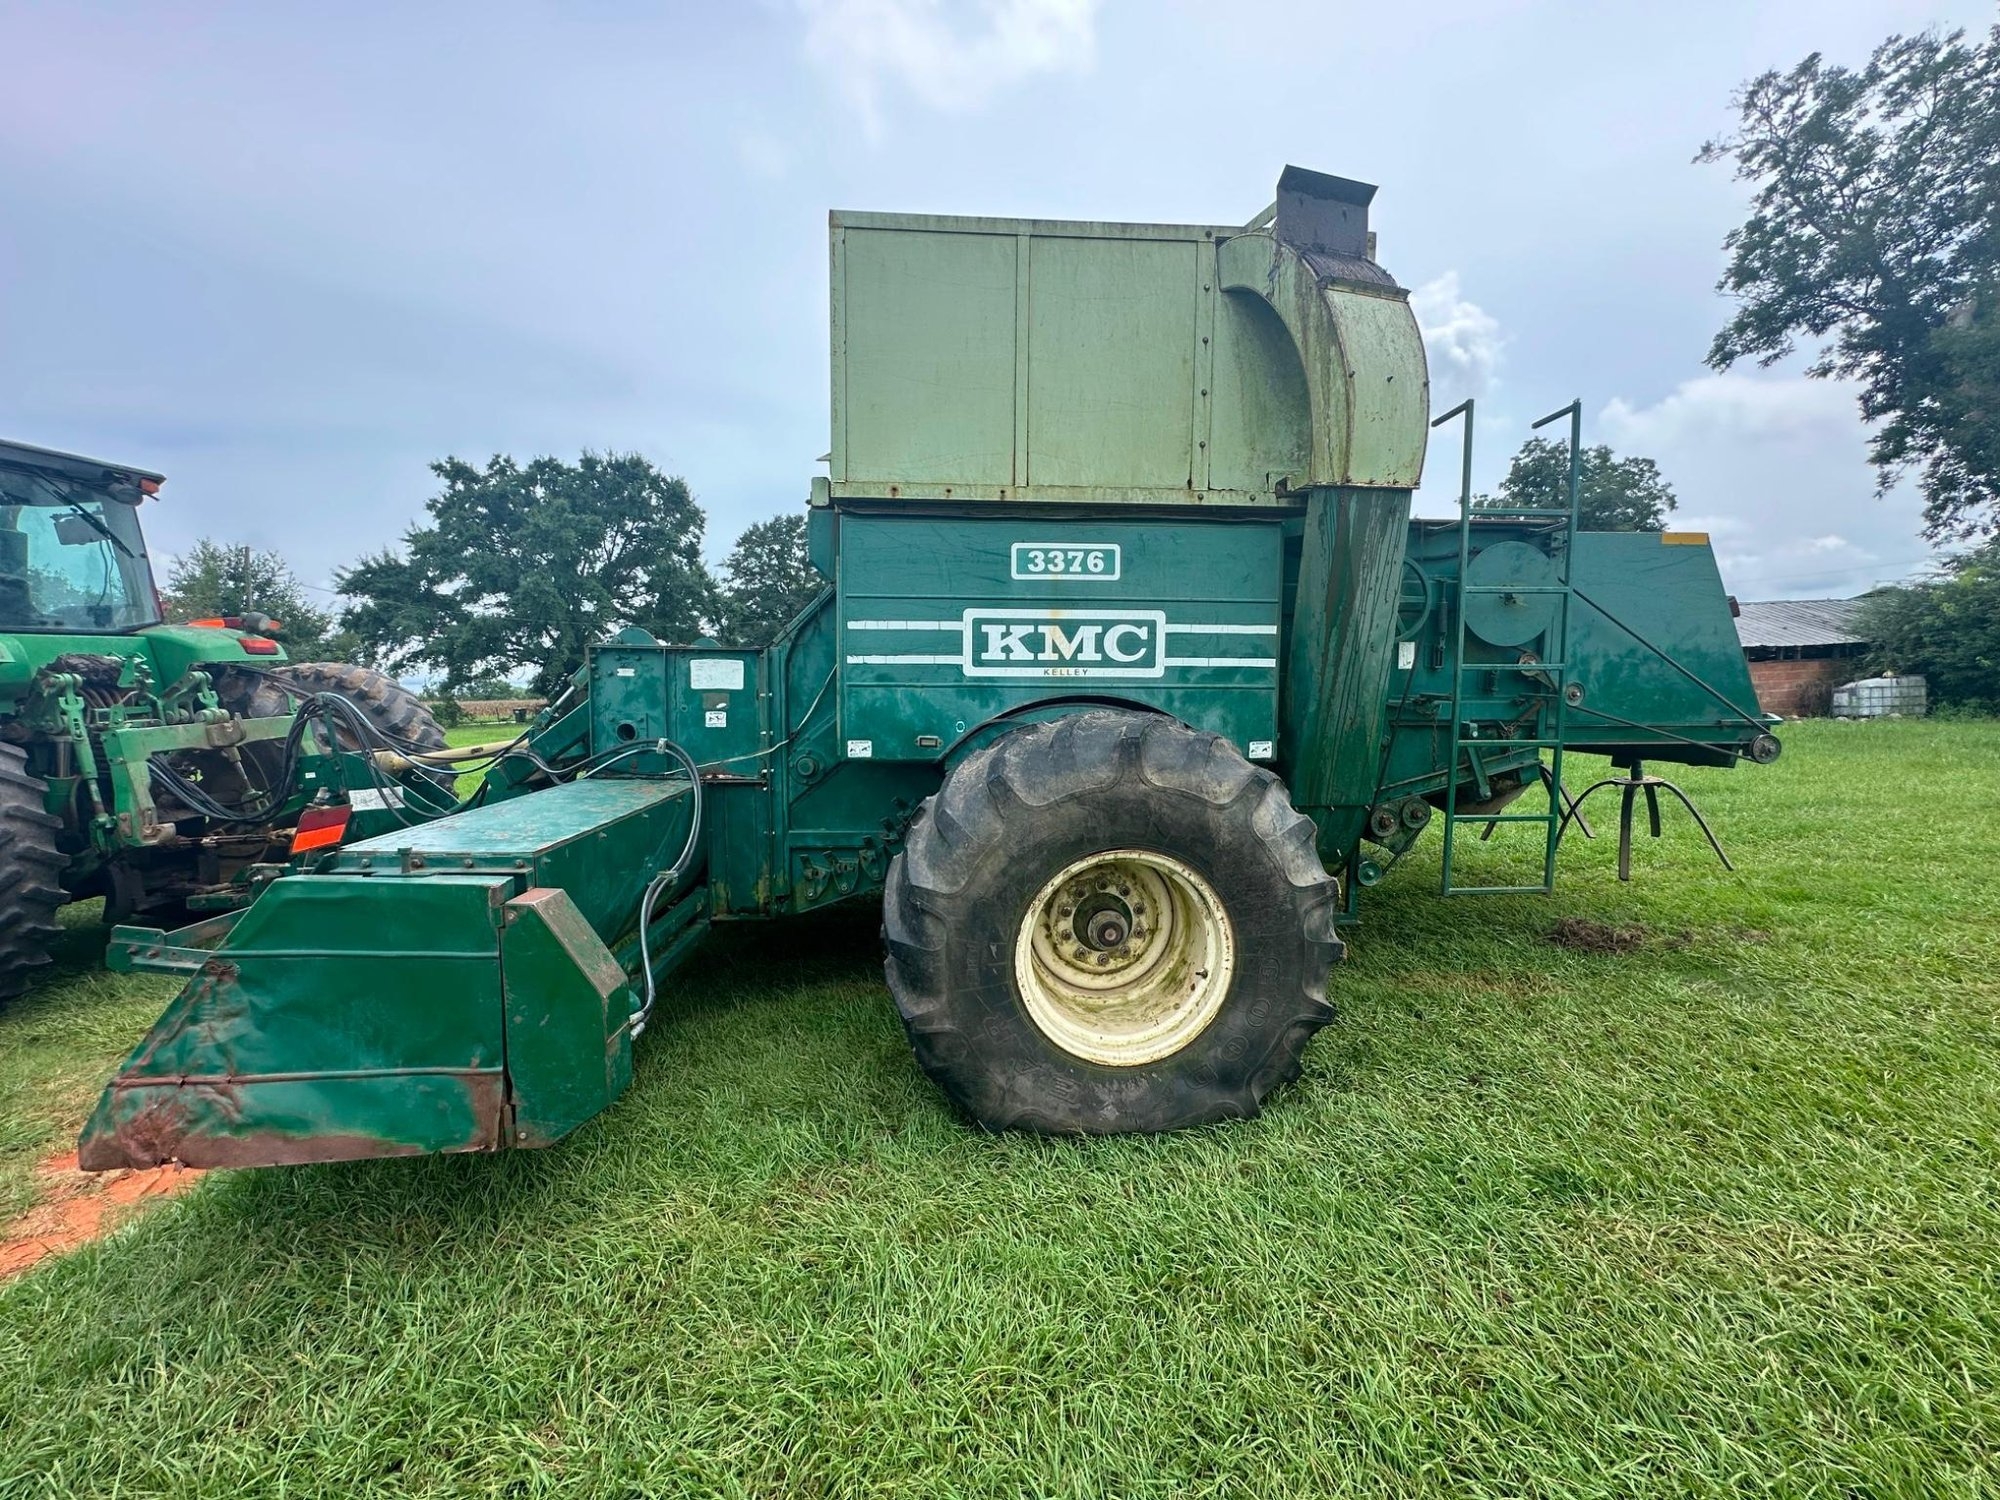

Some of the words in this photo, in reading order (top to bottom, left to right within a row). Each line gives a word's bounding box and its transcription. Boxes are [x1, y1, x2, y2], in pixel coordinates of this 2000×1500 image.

[1027, 550, 1105, 573] 3376
[981, 624, 1148, 663] KMC
[1043, 668, 1088, 676] KELLEY
